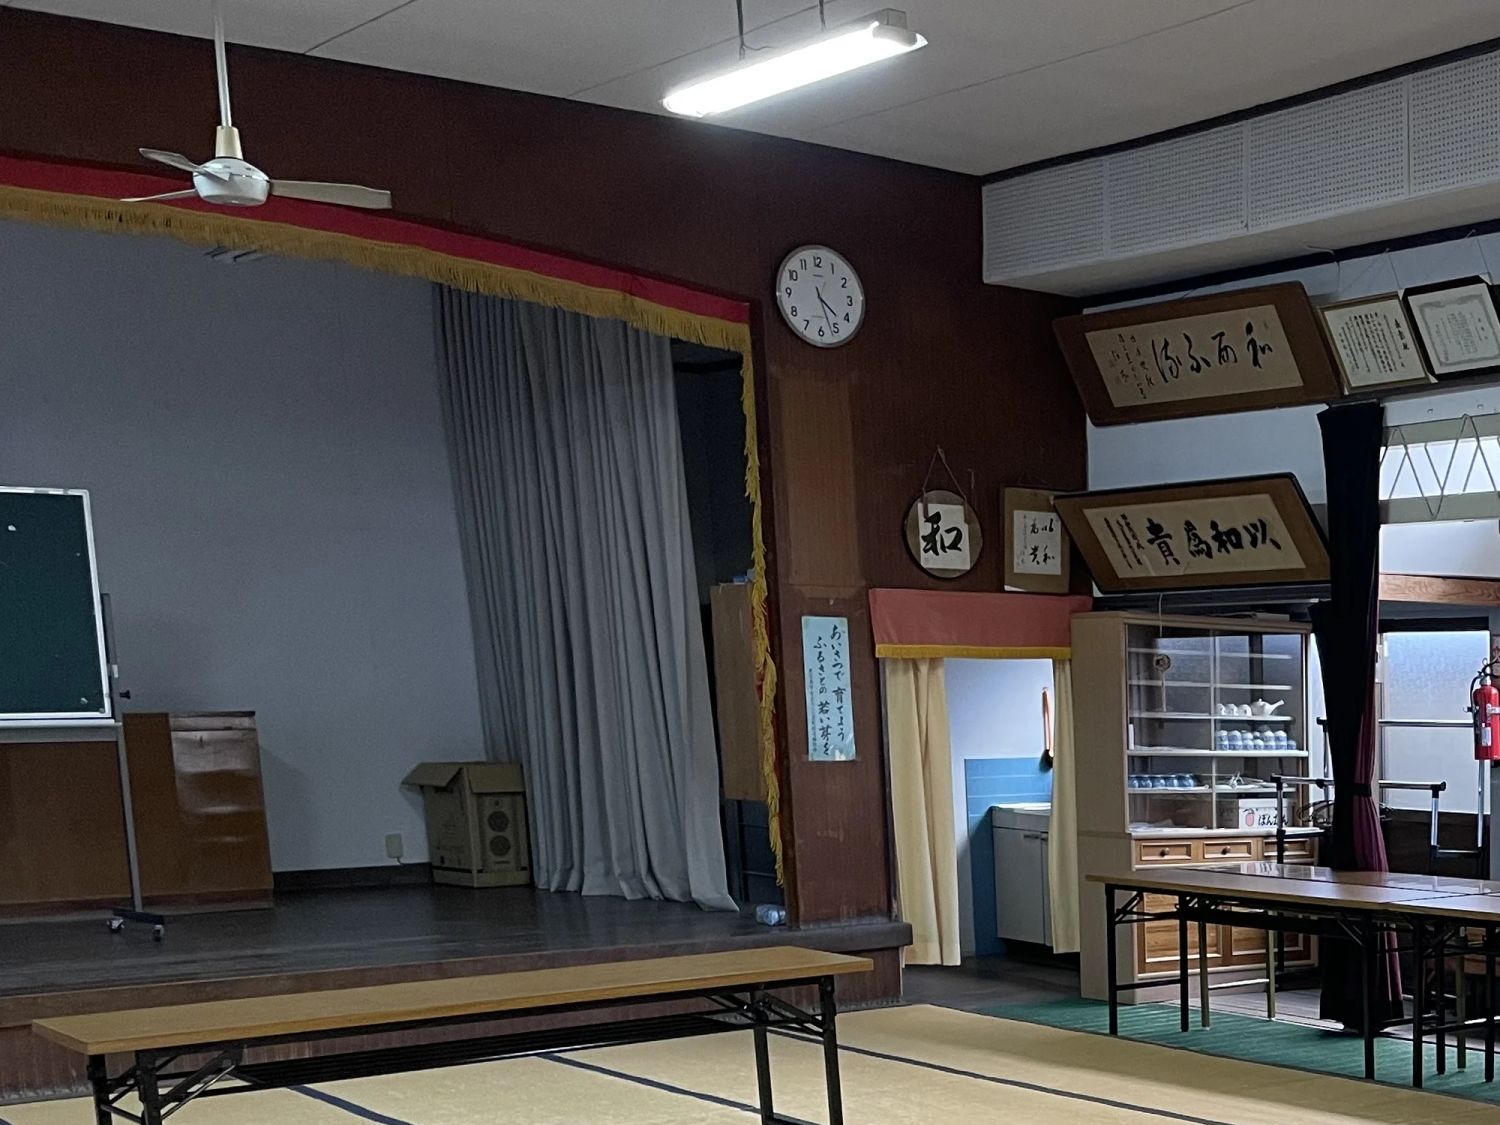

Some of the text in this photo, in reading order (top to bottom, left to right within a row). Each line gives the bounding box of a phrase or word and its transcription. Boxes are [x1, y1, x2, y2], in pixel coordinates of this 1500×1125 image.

[800, 259, 807, 270] 11
[813, 256, 822, 268] 12
[789, 269, 798, 281] 10
[841, 277, 847, 288] 2
[785, 287, 792, 298] 9
[846, 295, 853, 306] 3
[791, 306, 798, 317] 8
[844, 312, 850, 323] 4
[803, 319, 809, 331] 7
[833, 323, 839, 334] 5
[818, 326, 825, 337] 6
[921, 511, 963, 556] 和
